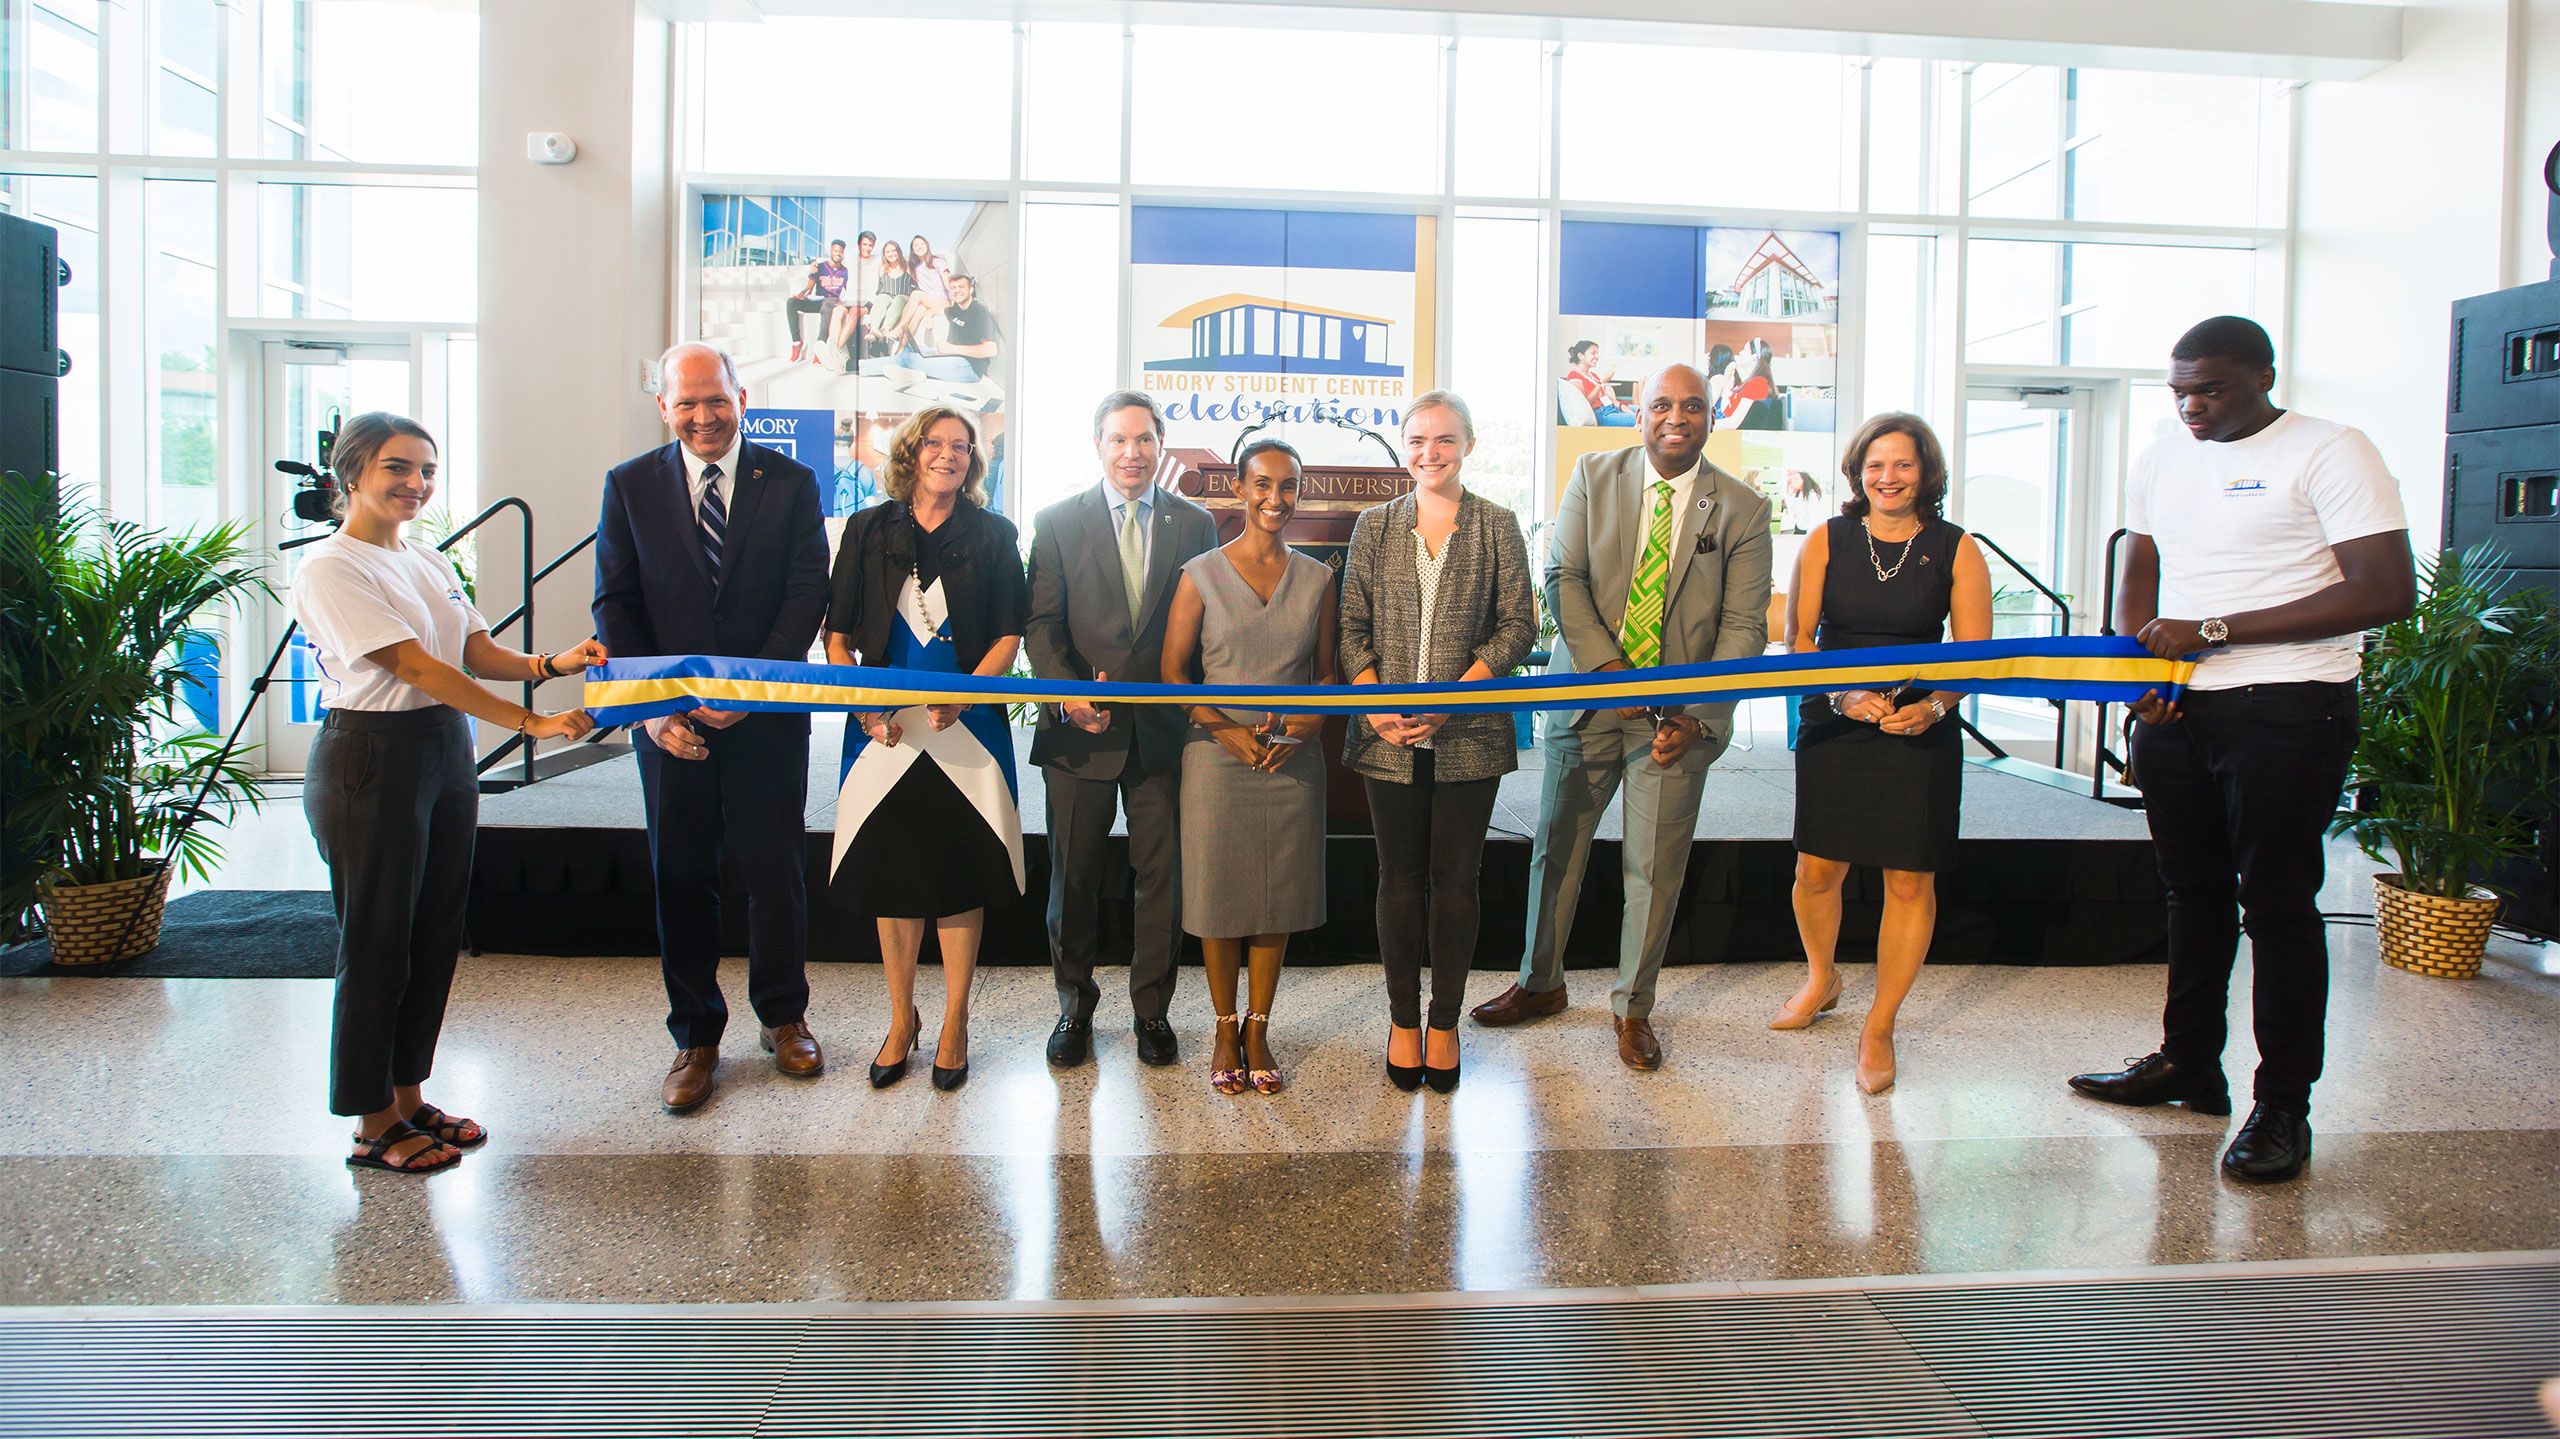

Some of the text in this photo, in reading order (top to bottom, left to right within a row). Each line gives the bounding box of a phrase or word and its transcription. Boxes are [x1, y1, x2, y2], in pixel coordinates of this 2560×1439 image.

[1144, 374, 1403, 397] EMORY STUDENT CENTER
[1303, 476, 1417, 496] NIVERSIT
